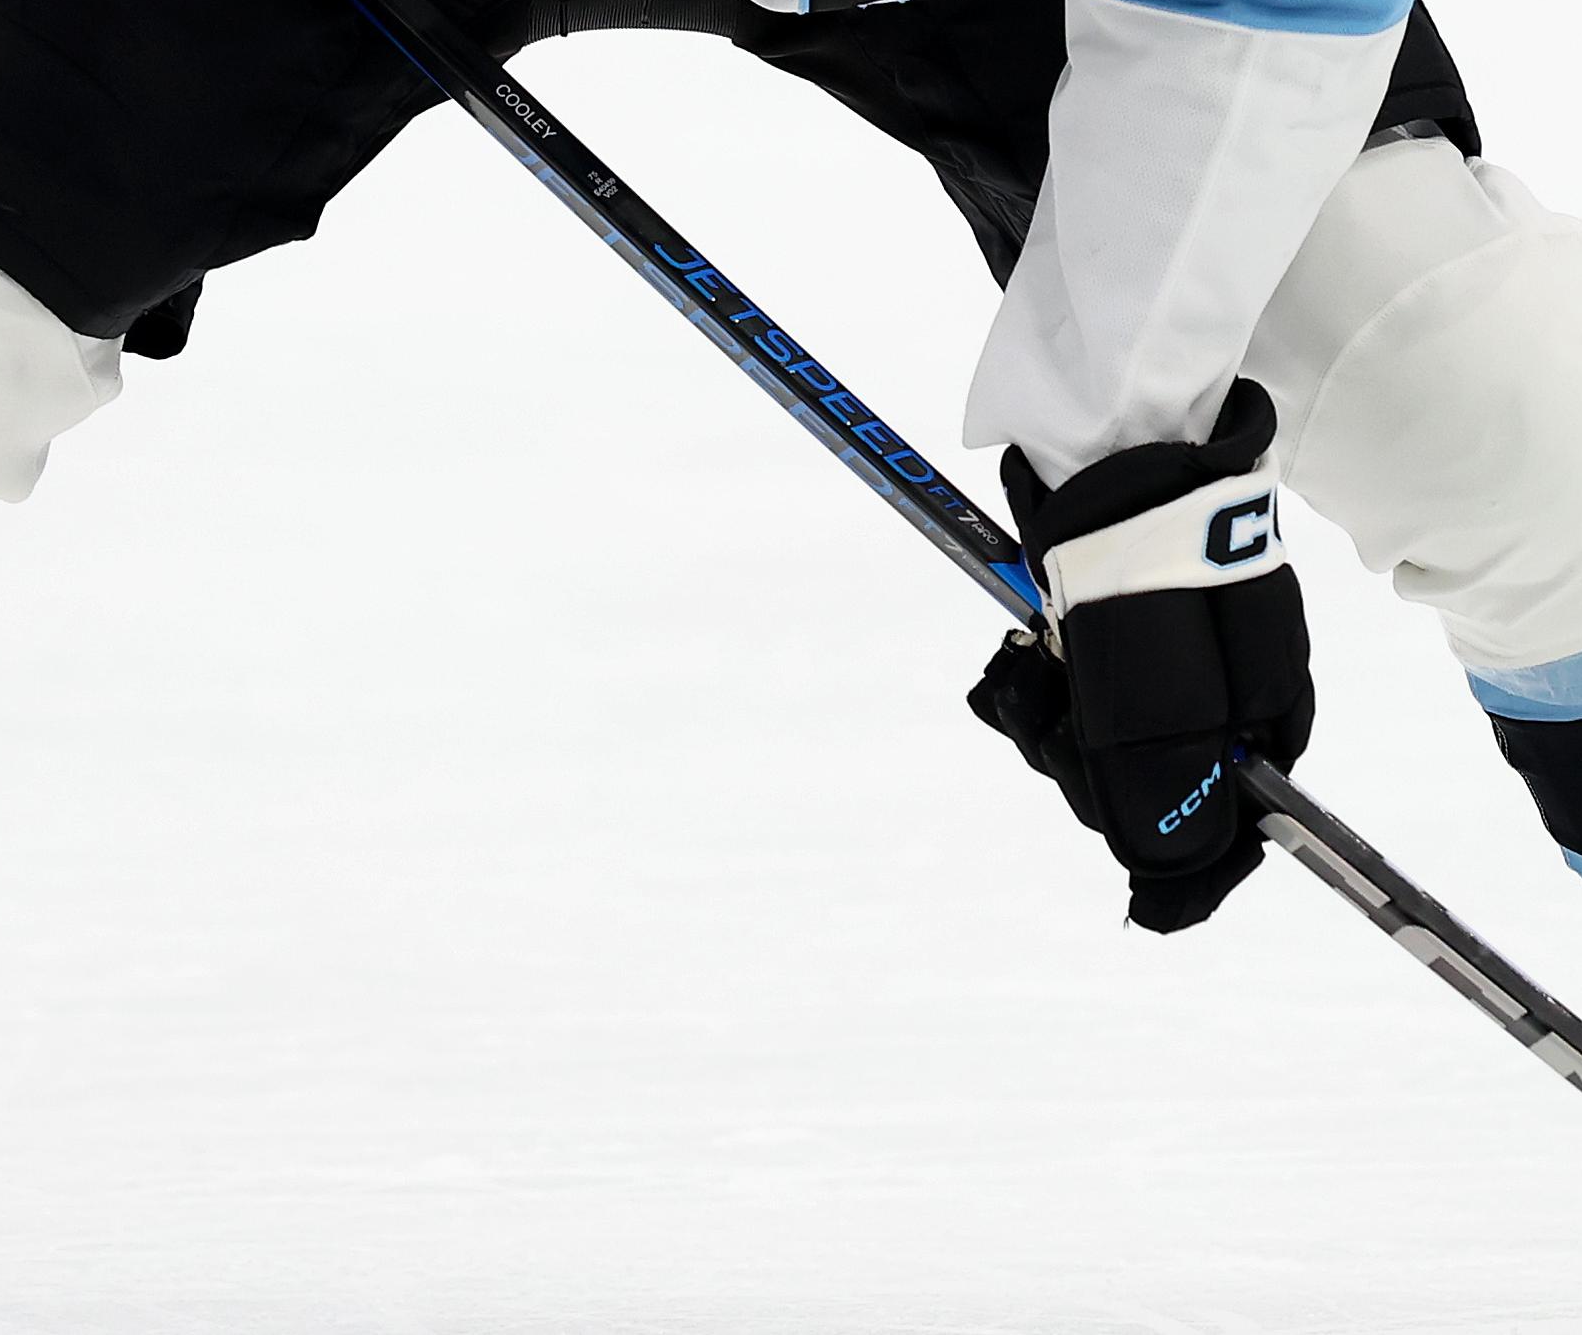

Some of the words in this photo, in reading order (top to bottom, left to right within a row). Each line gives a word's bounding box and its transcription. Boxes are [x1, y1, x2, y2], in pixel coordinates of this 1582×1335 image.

[495, 83, 557, 140] COOLEY
[654, 241, 934, 484] JETSPEED
[1158, 760, 1221, 835] CCM
